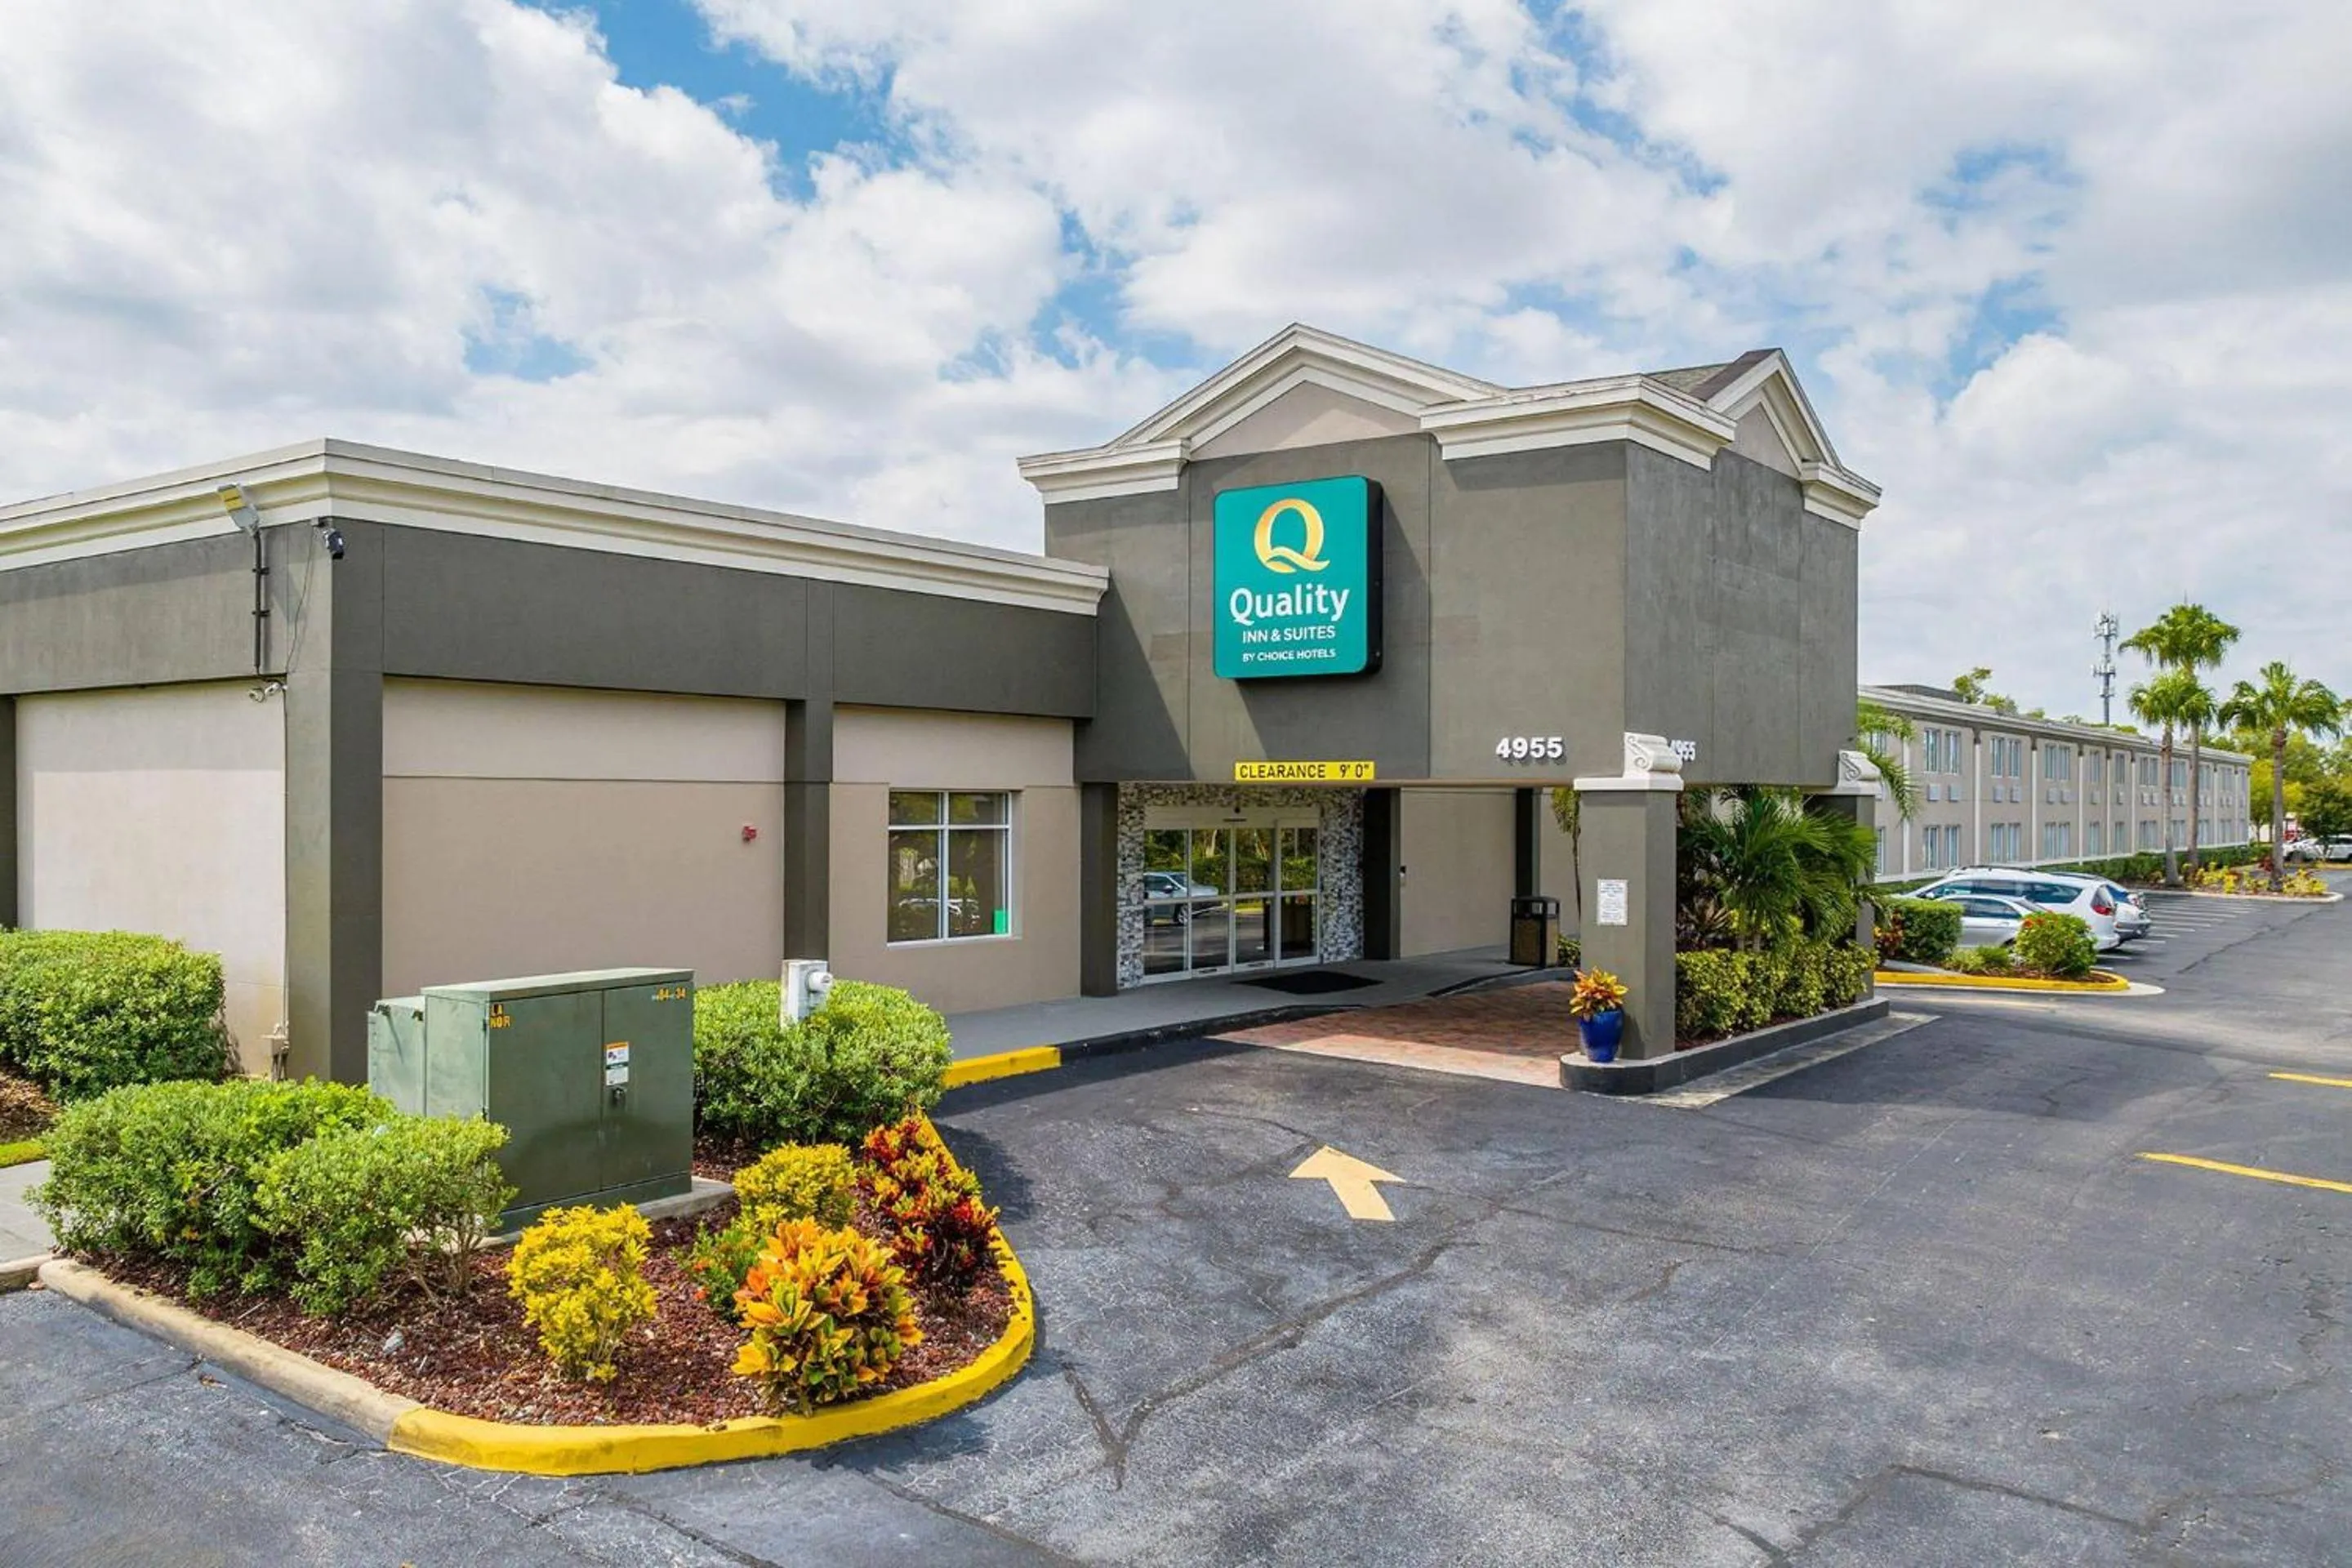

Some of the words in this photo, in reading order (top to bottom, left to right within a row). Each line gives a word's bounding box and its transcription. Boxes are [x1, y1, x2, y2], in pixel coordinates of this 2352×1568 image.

[1254, 498, 1330, 573] Q
[1230, 583, 1350, 626] Quality
[1242, 630, 1268, 644] INN
[1271, 628, 1281, 642] &
[1284, 626, 1335, 641] SUITES
[1242, 653, 1255, 662] BY
[1257, 650, 1294, 661] CHOICE
[1296, 648, 1336, 659] HOTELS
[1495, 737, 1563, 759] 4955
[1240, 764, 1325, 778] CLEARANCE
